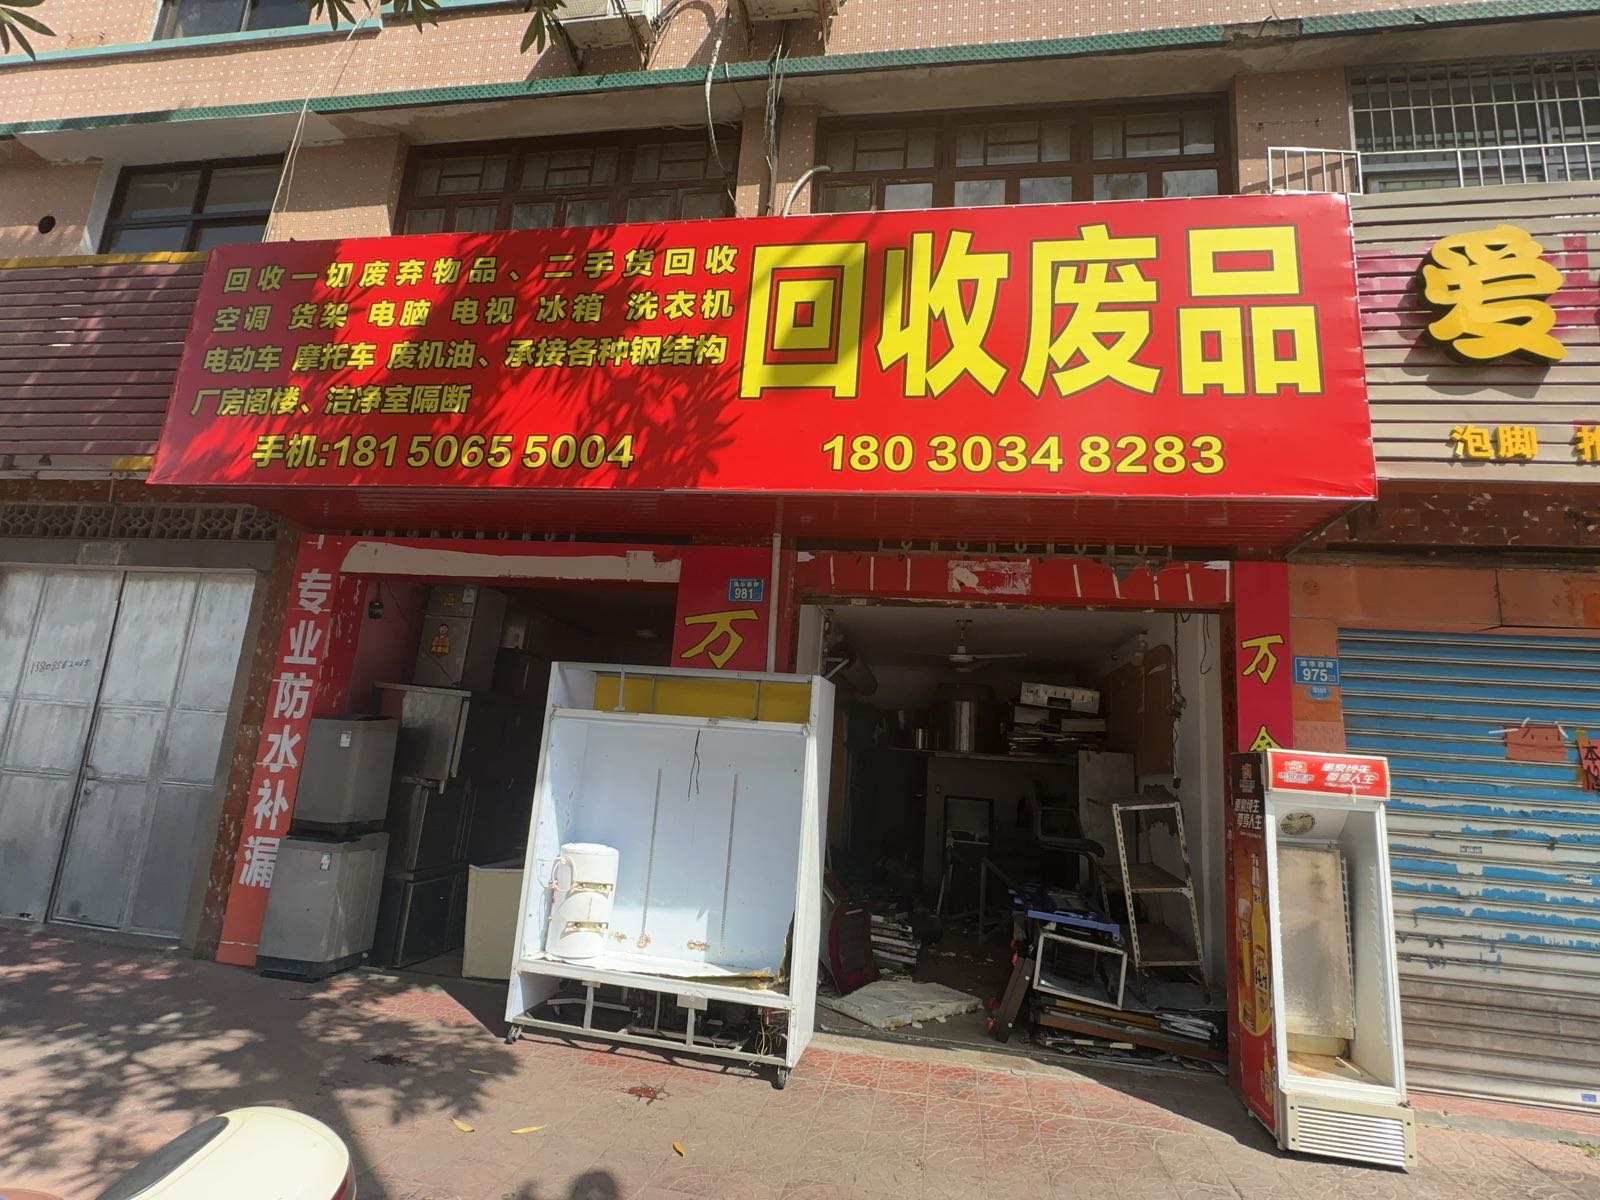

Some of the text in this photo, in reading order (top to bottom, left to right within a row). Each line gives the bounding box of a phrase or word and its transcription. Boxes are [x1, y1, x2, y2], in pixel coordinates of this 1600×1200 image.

[222, 244, 738, 293] 回收一切废弃物品、二手货回收
[213, 288, 734, 333] 空调 货架 电脑 电视 冰箱 洗衣机
[739, 223, 1325, 399] 回收废品
[202, 345, 282, 373] 电动车
[291, 342, 377, 372] 摩托车
[190, 383, 472, 416] 厂房阁楼、洁净室隔断
[821, 434, 1226, 474] 180 3034 8283
[1450, 424, 1538, 459] 泡脚
[735, 588, 754, 600] 981
[680, 608, 760, 669] 万
[1302, 668, 1328, 682] 975
[238, 567, 332, 889] 专业防水补漏
